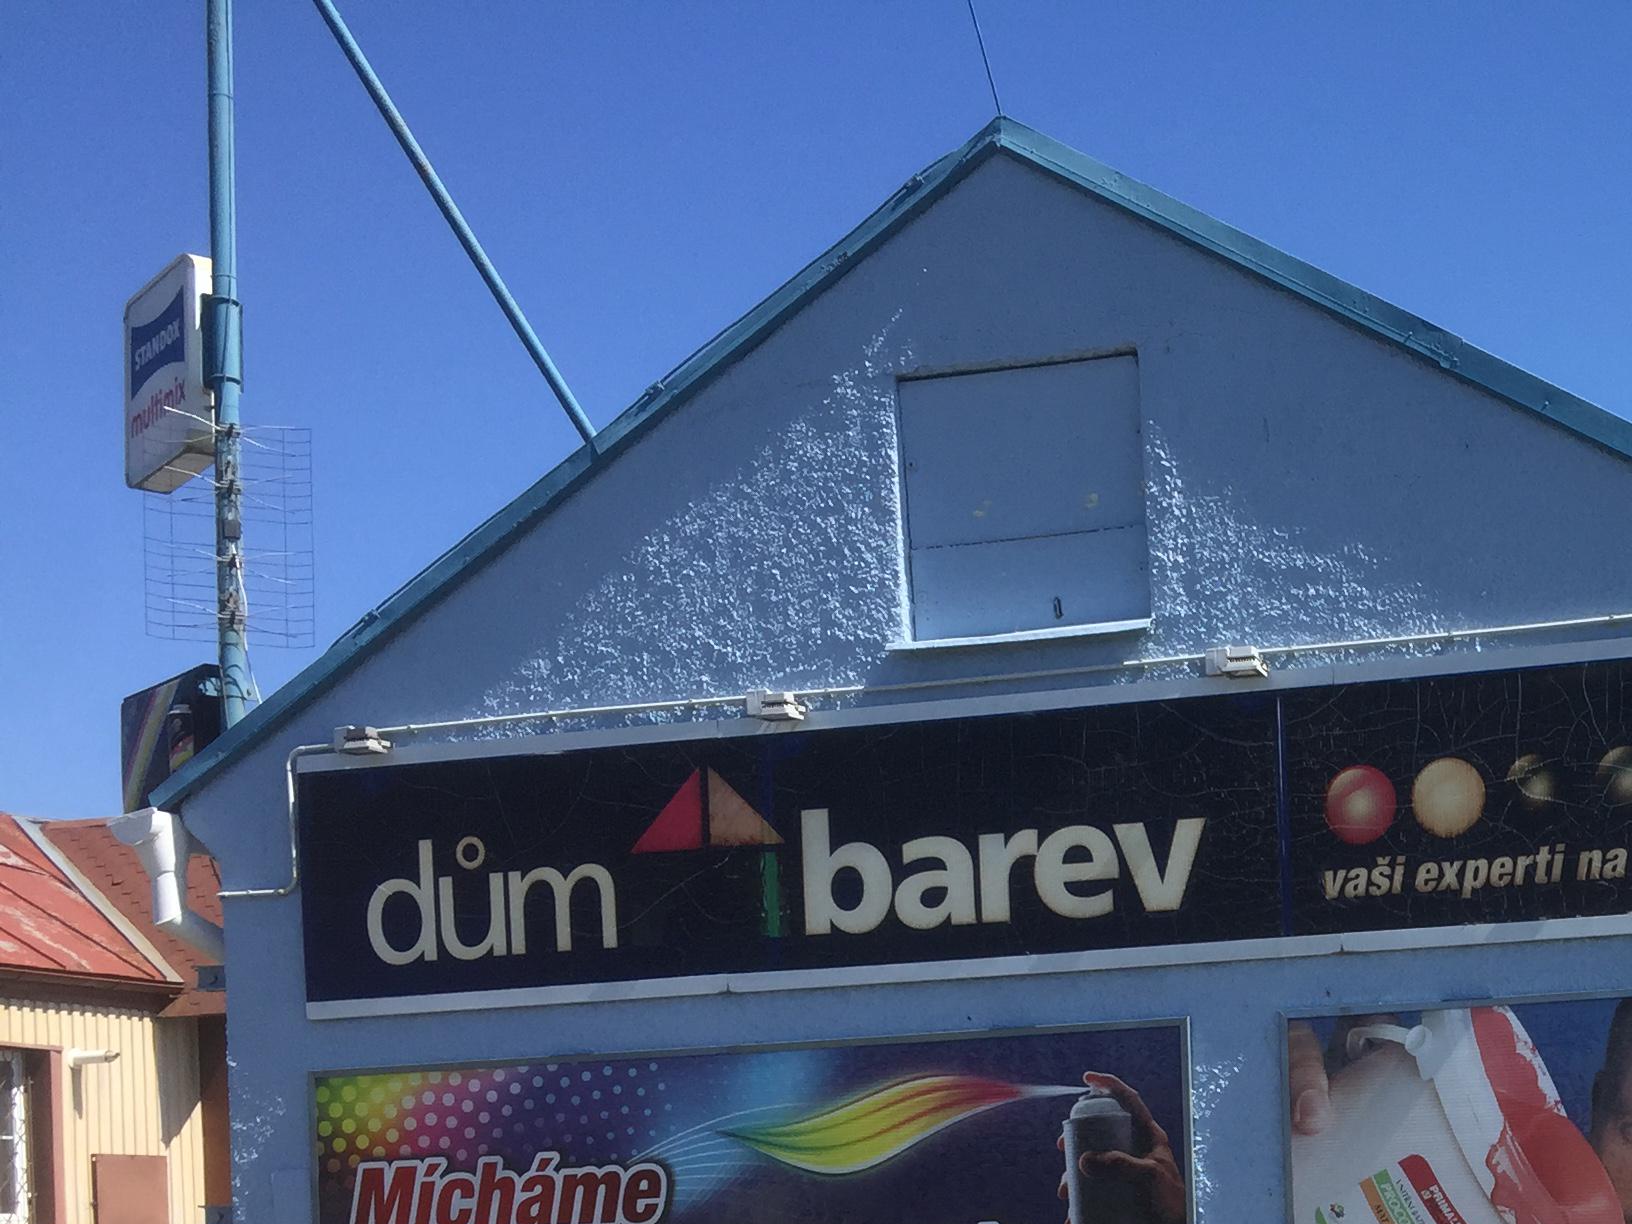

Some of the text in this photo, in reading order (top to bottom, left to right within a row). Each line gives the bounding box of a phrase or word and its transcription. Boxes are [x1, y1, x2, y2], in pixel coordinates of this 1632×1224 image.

[135, 320, 180, 371] STANDOX
[131, 377, 186, 439] multimix
[366, 808, 1207, 966] dům barev
[1323, 855, 1405, 899] vaši
[1415, 844, 1566, 899] experti
[1577, 845, 1627, 882] na
